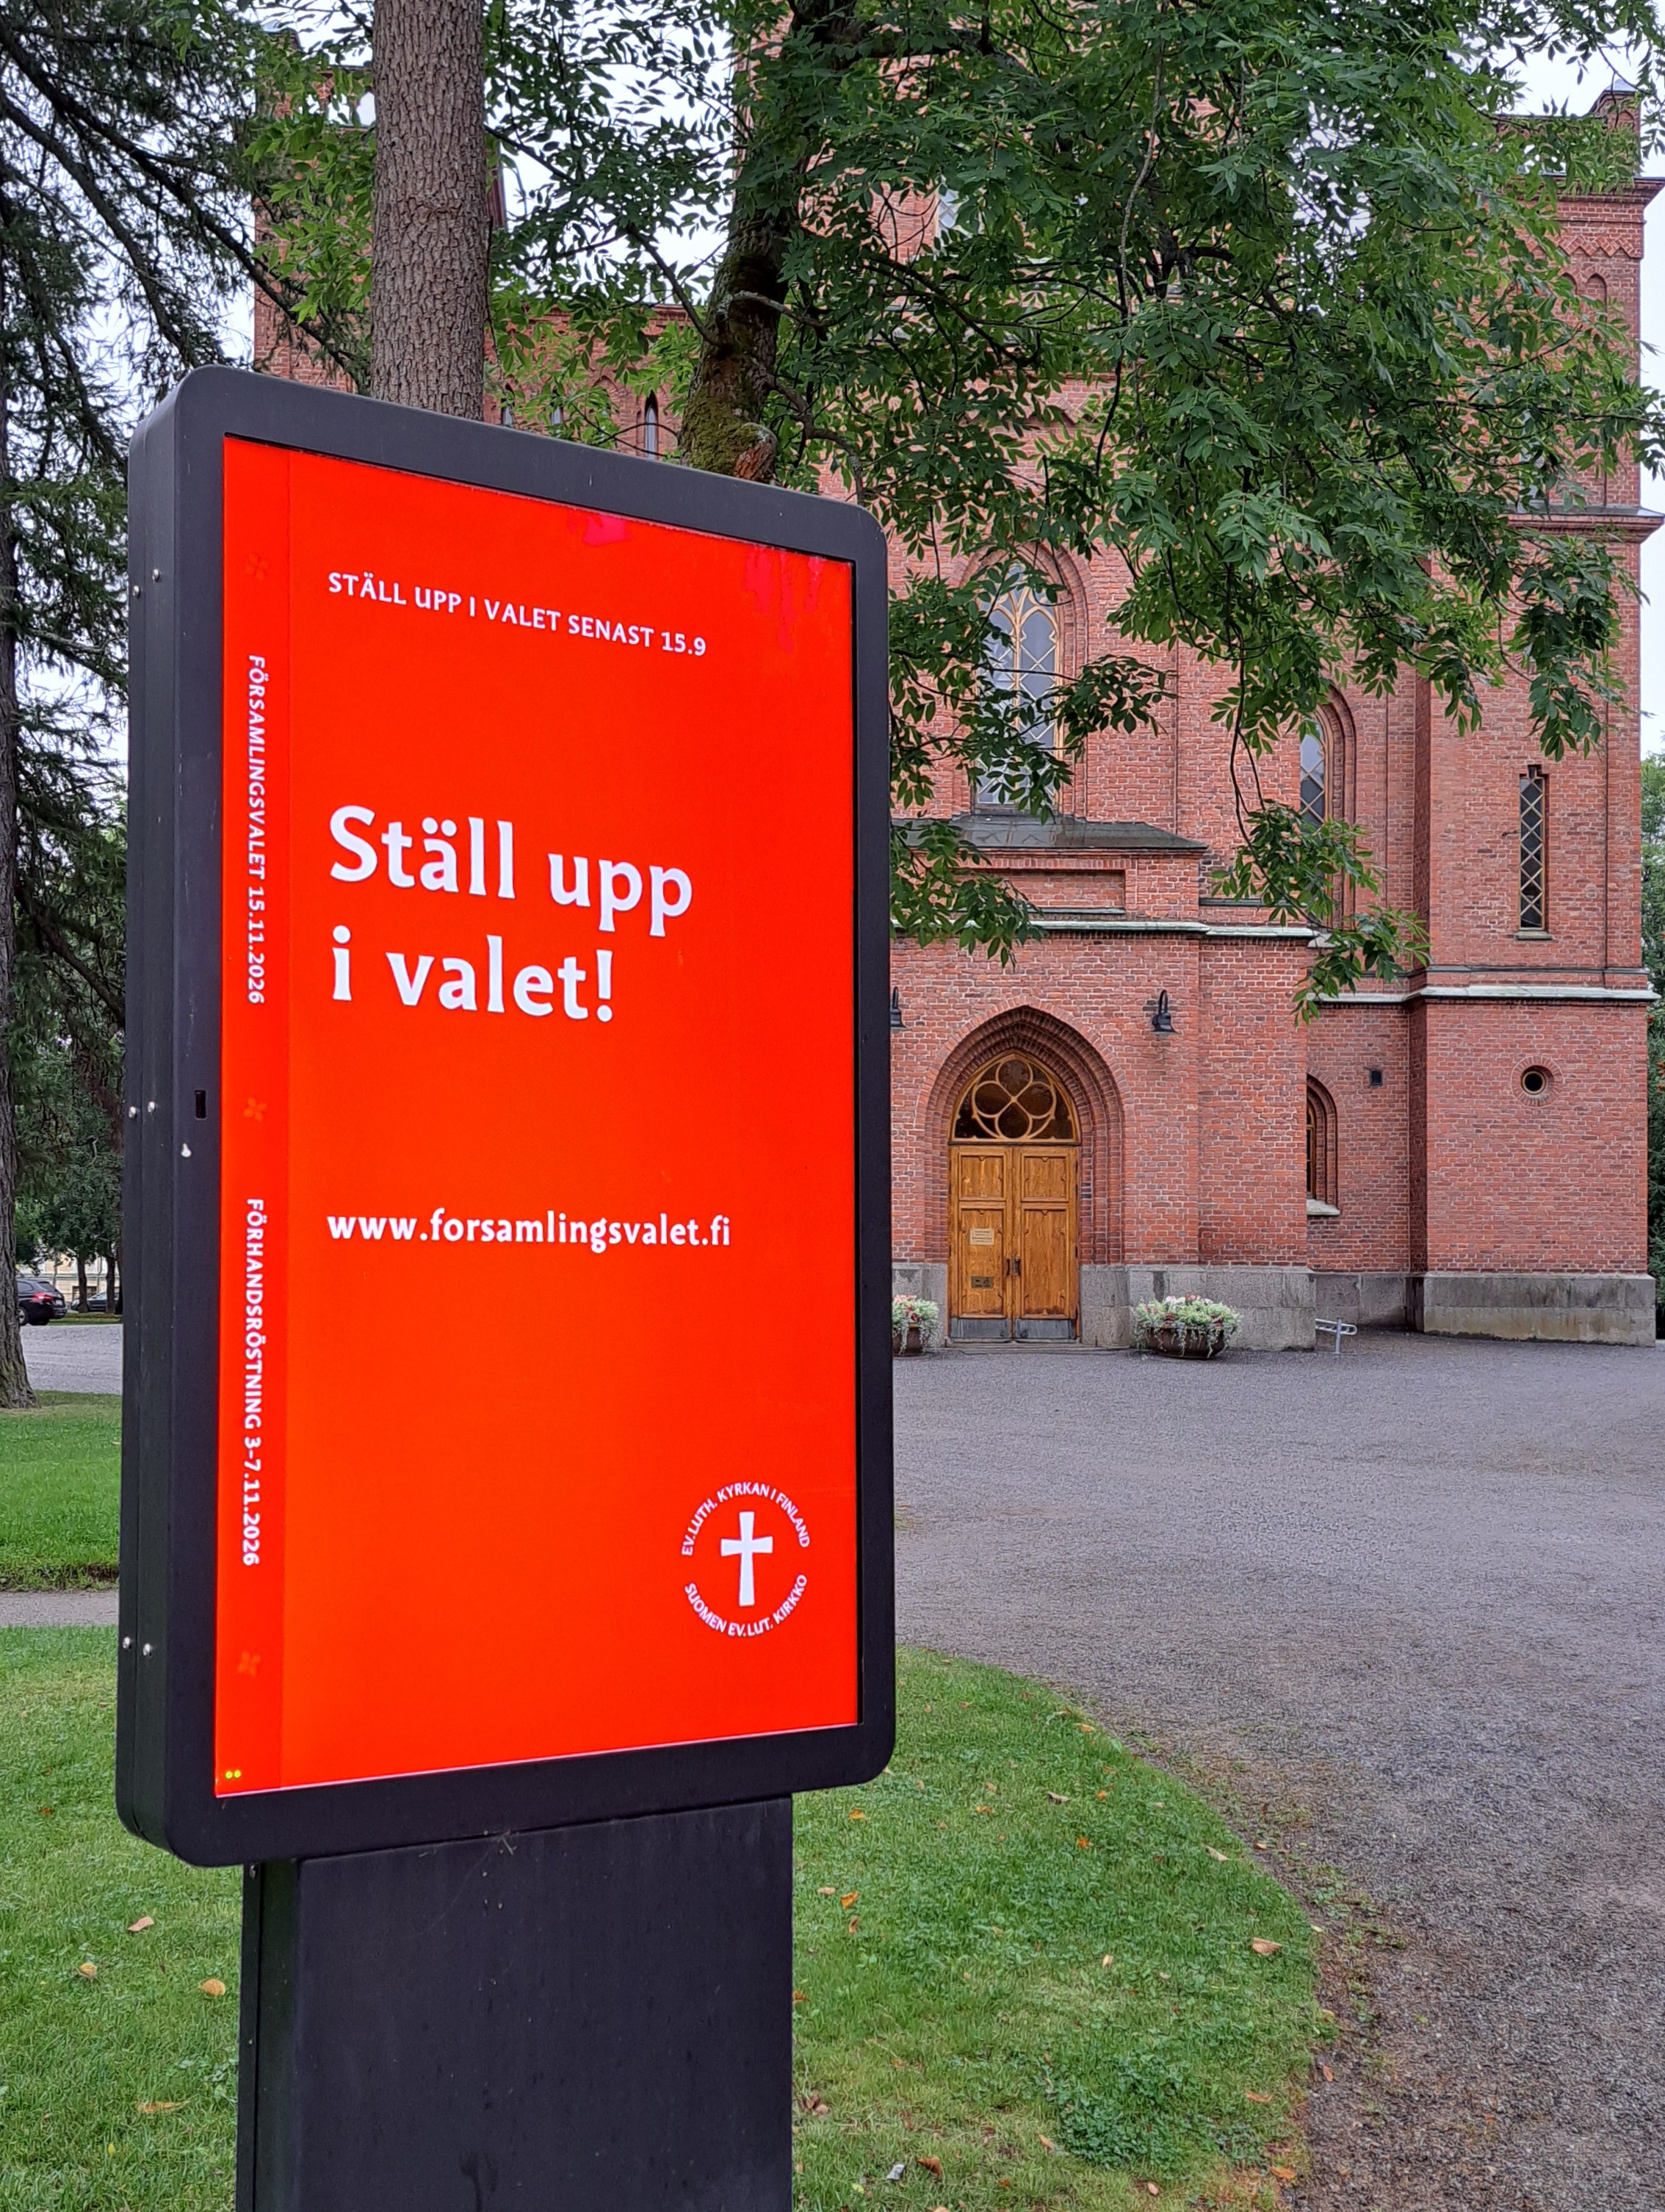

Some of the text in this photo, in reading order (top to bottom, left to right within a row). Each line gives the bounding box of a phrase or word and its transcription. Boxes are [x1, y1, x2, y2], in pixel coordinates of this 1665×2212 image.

[328, 571, 707, 657] STÄLL UPP I VALET SENAST 15.9
[247, 654, 270, 1005] FÖRSAMLINGSVALET 15.11.2026
[328, 804, 693, 938] Ställ upp
[331, 924, 614, 1023] i valet!
[326, 1207, 731, 1254] www.forsamlingsvalet.fi
[243, 1198, 269, 1430] FÖRHANDSRÖSTNING
[716, 1481, 770, 1503] KYRKAN
[769, 1488, 777, 1501] I
[775, 1492, 811, 1548] FINLAND
[684, 1582, 728, 1634] SUOMEN
[772, 1574, 808, 1625] KIRKKO
